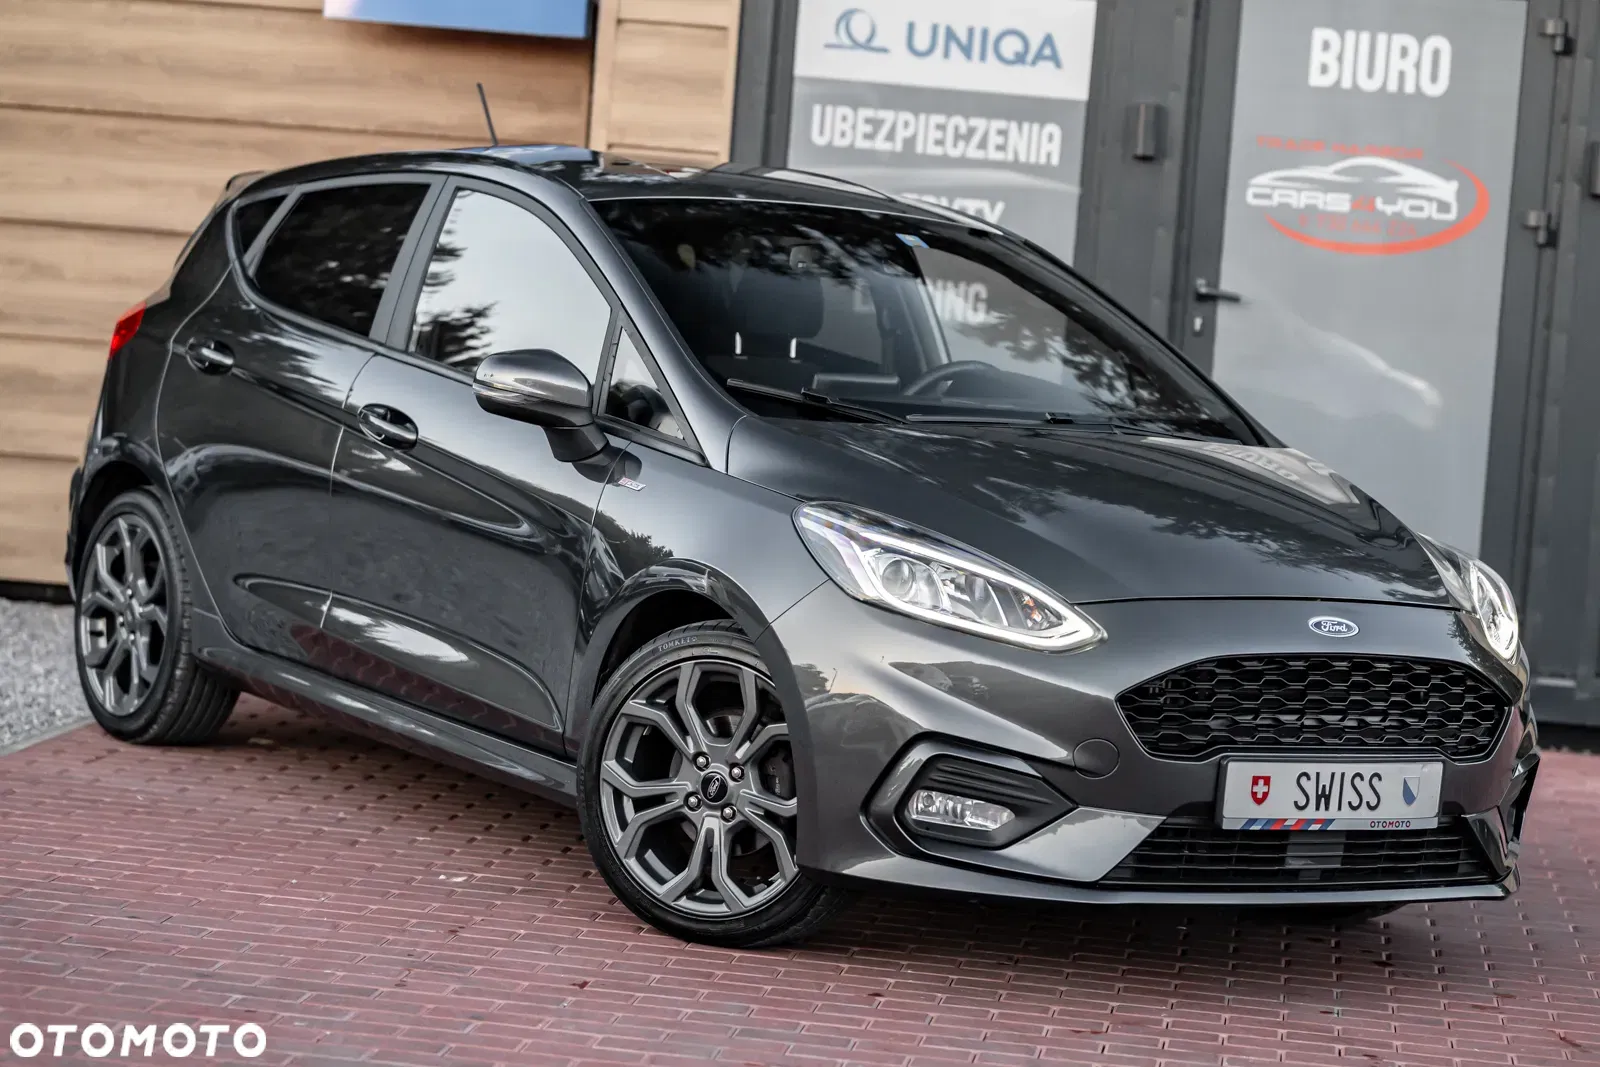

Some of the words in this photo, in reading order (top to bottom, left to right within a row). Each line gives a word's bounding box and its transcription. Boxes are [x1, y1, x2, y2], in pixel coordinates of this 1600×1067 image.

[905, 20, 1063, 70] UNIQA
[1307, 27, 1453, 98] BIURO
[809, 103, 1063, 168] UBEZPIECZENIA
[1320, 620, 1348, 632] Ford
[1293, 771, 1383, 812] SWISS
[1369, 820, 1411, 829] OTOMOTO
